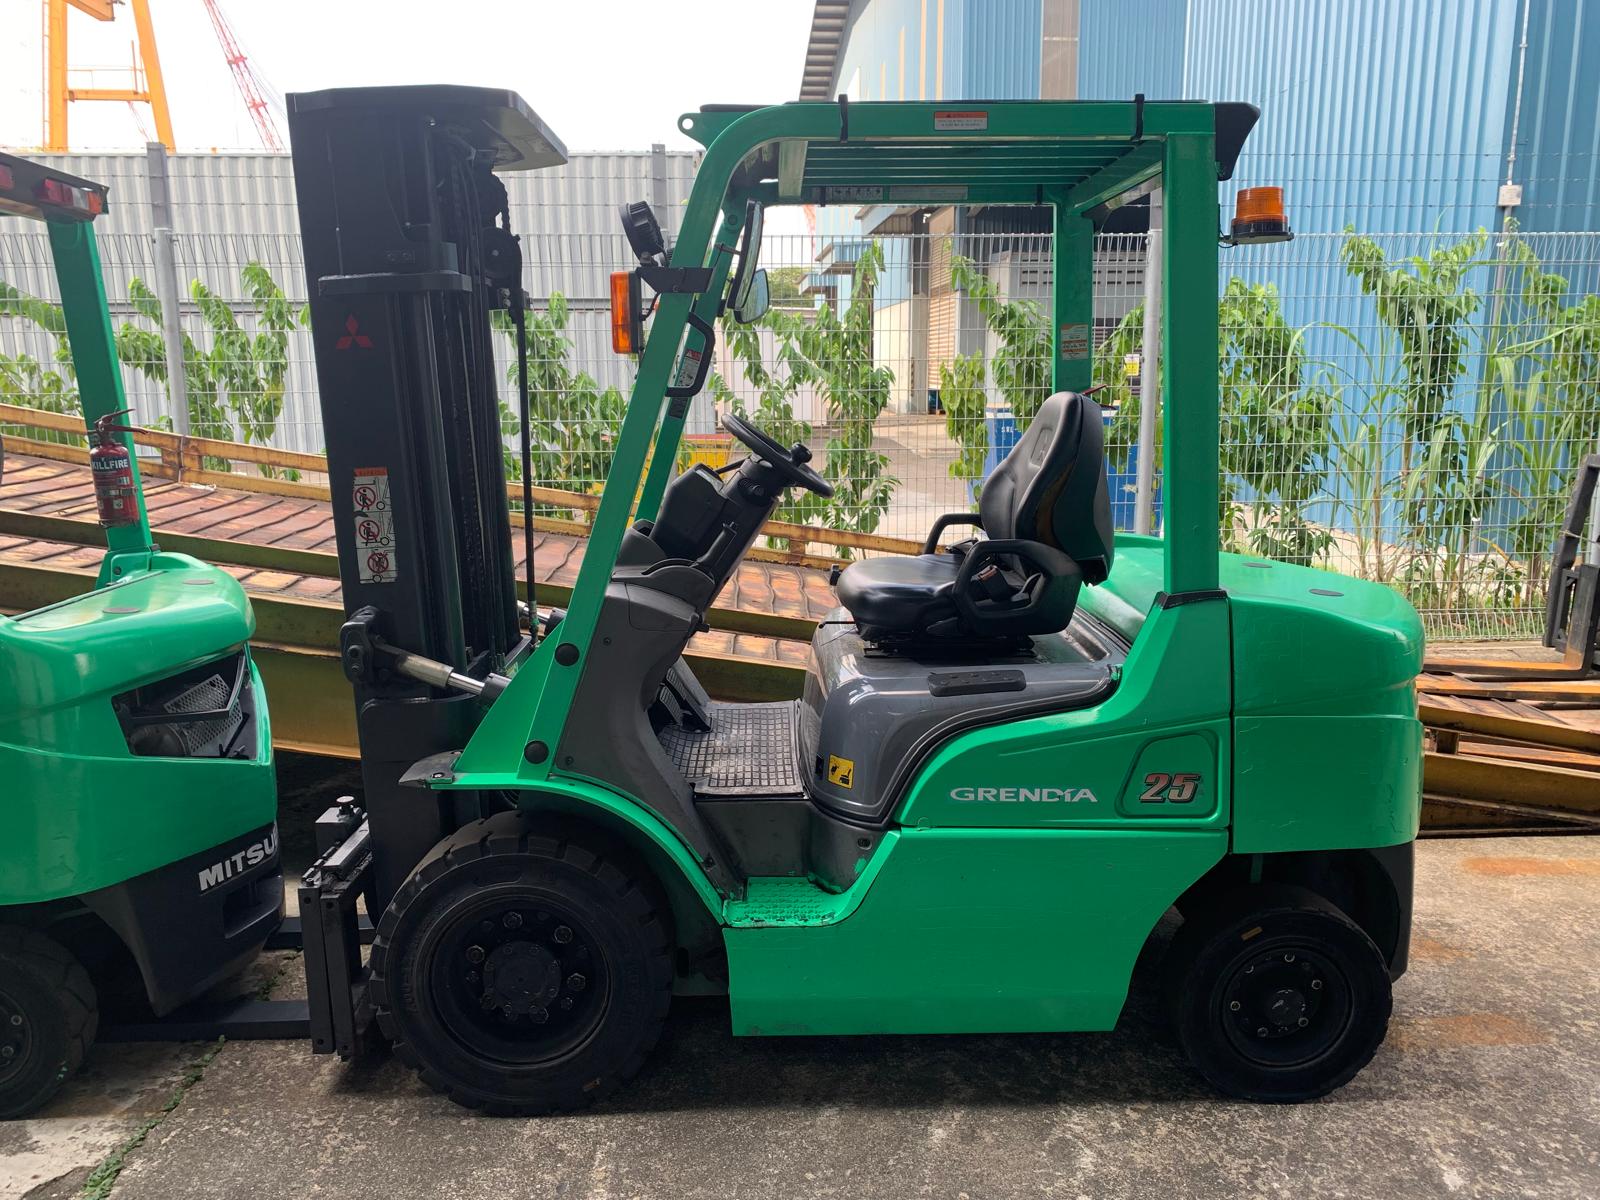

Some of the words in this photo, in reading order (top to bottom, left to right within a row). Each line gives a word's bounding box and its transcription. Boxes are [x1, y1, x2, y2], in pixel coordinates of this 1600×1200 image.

[91, 458, 129, 470] KILLFIRE
[950, 787, 1098, 803] GRENDIA
[1139, 772, 1202, 803] 25
